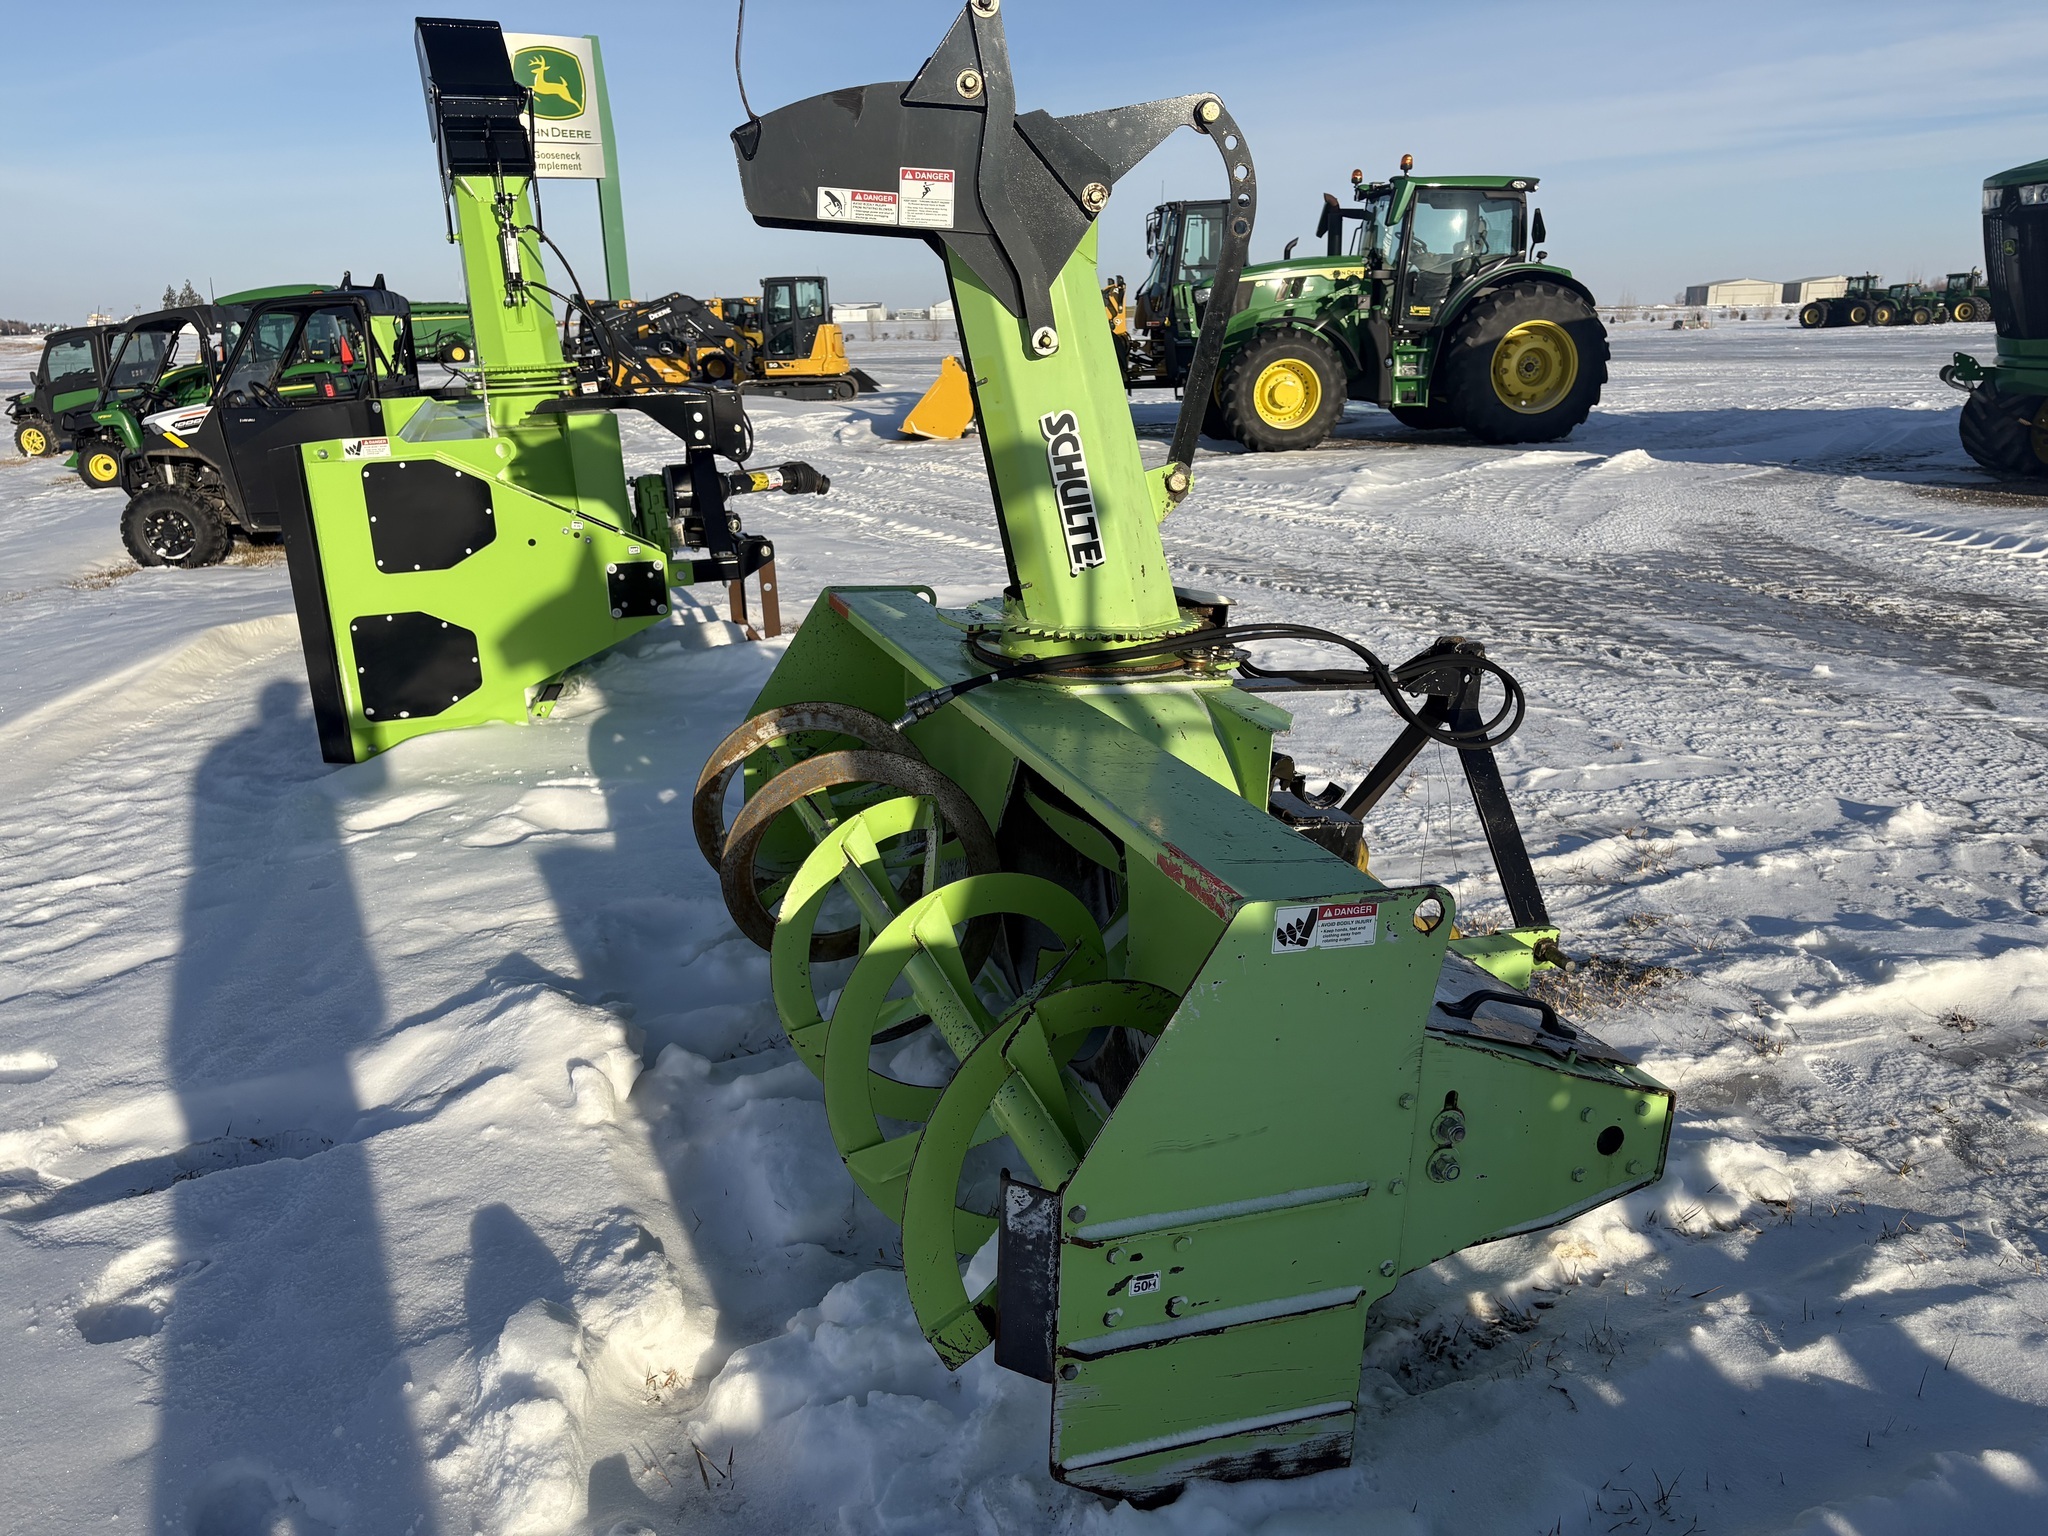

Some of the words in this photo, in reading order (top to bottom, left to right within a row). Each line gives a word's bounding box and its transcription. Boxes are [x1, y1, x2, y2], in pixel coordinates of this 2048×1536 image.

[551, 127, 592, 139] DEERE
[534, 150, 581, 161] Gooseneck
[538, 162, 583, 172] mplement
[915, 171, 950, 181] DANGER
[863, 192, 893, 203] DANGER
[648, 307, 672, 321] DEERE
[1043, 412, 1104, 565] SCHULTE
[1334, 905, 1373, 916] DANGER
